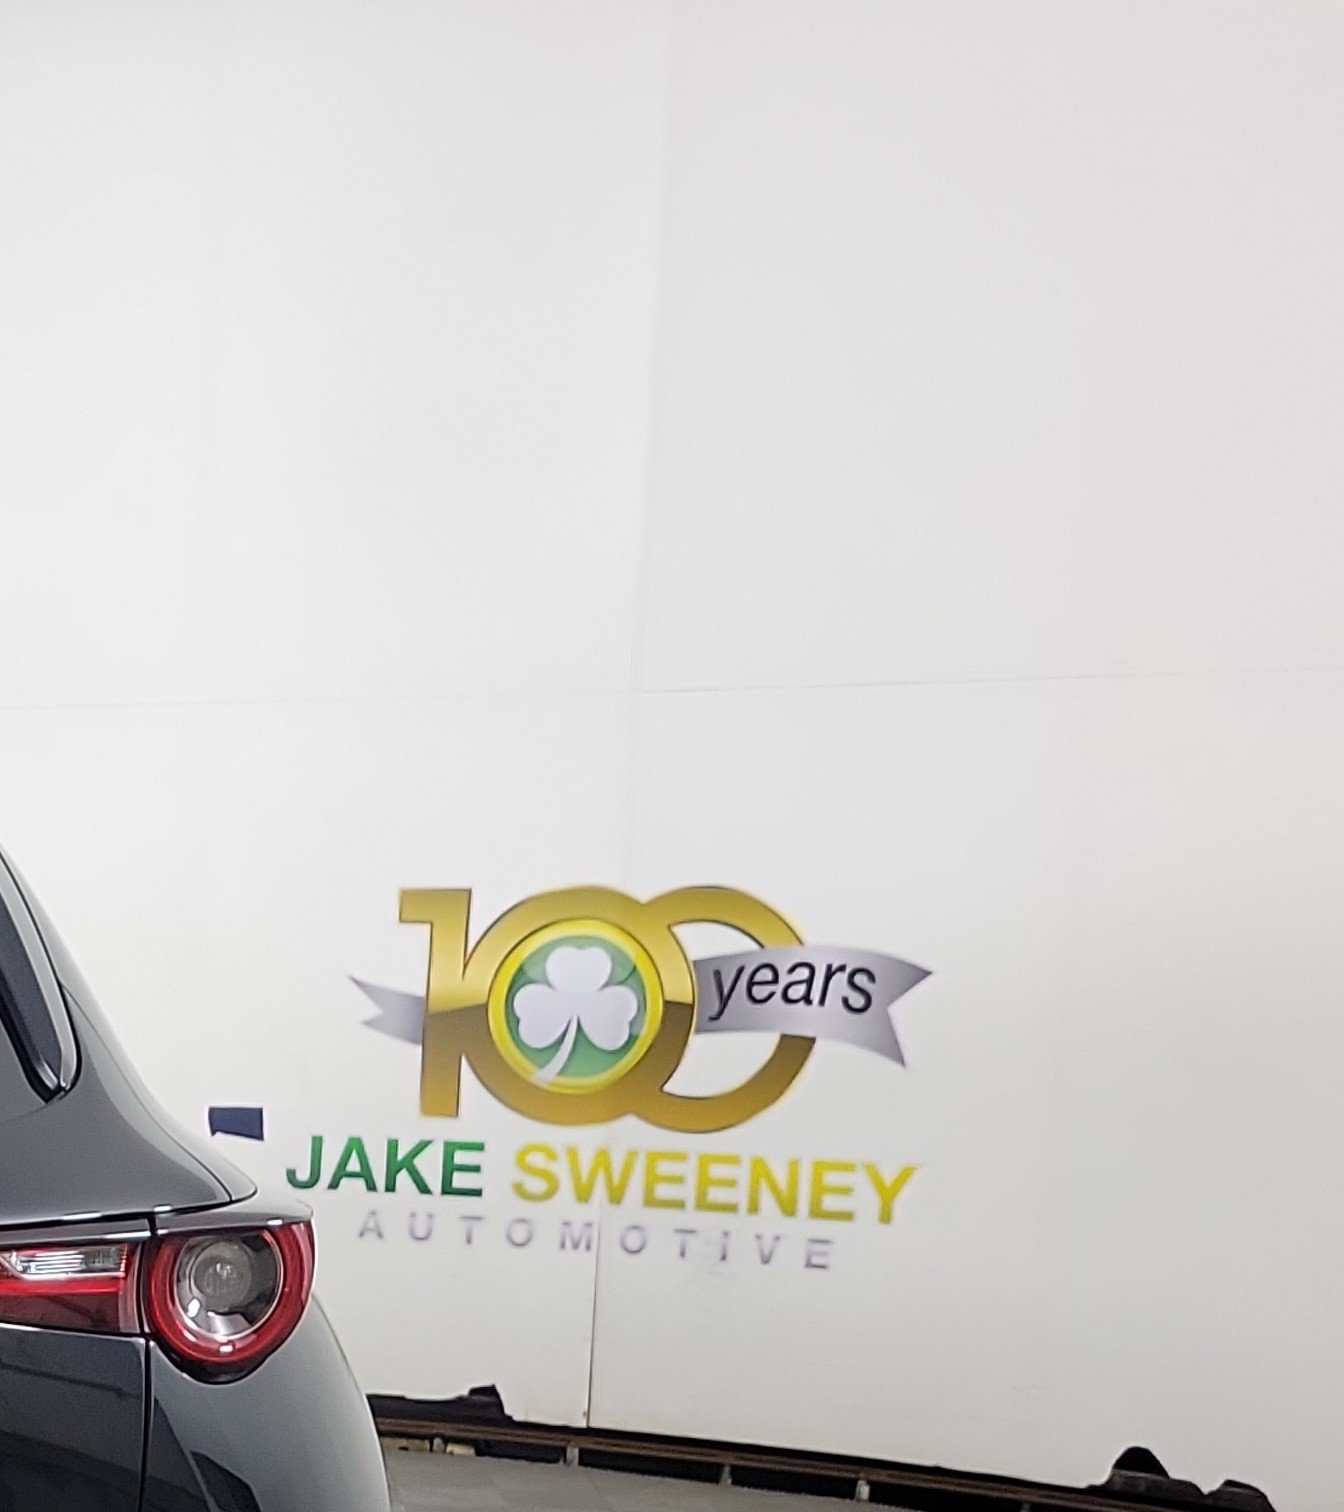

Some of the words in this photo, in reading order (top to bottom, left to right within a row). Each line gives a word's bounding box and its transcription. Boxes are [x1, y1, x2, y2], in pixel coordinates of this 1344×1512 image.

[708, 961, 876, 1022] years
[285, 1134, 486, 1197] JAKE
[513, 1141, 919, 1225] SWEENEY
[358, 1210, 835, 1270] AUTOMOTIVE
